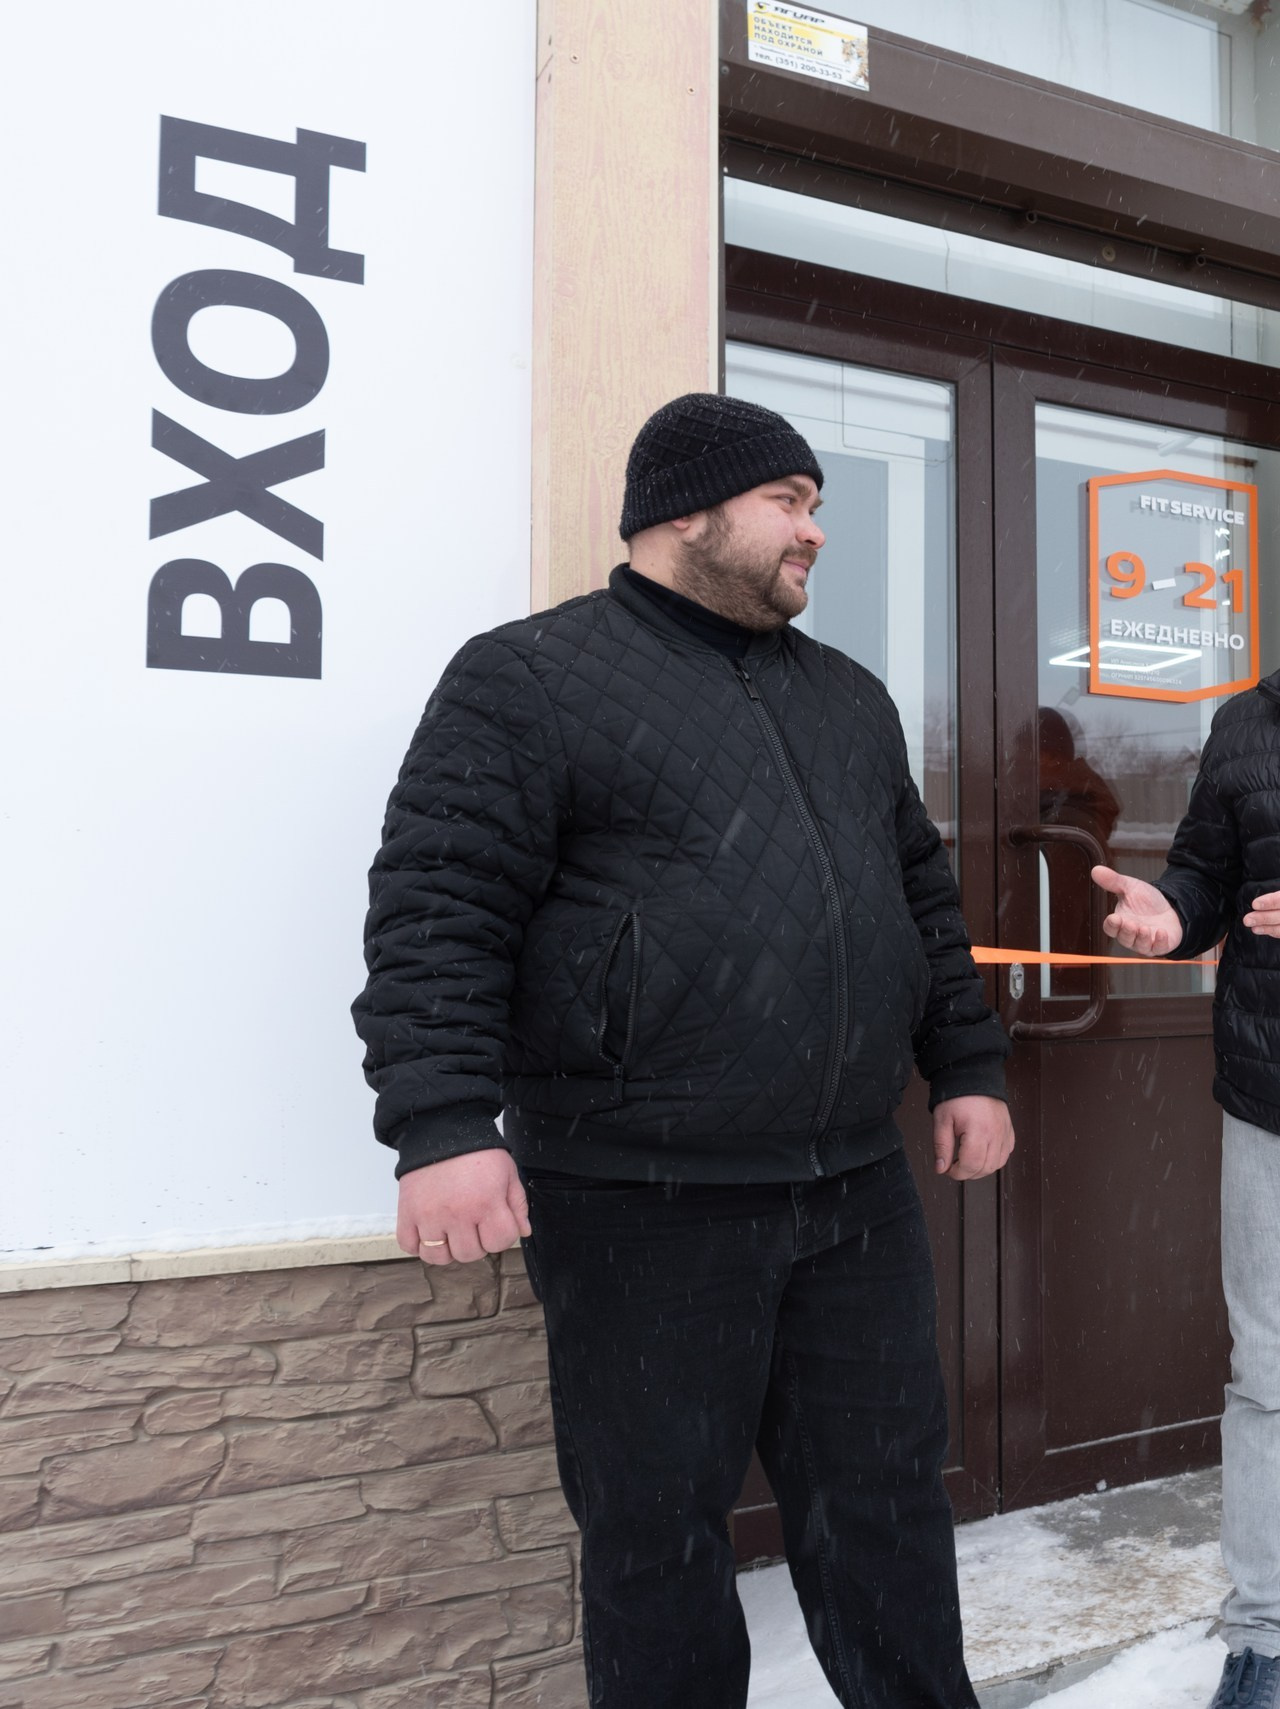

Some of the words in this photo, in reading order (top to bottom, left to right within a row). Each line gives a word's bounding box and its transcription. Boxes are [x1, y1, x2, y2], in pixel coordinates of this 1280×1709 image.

[754, 17, 792, 31] ОБЪЕКТ
[754, 24, 813, 45] НАХОДИТСЯ
[754, 33, 775, 43] ПОД
[777, 39, 823, 56] ОХРАНОЙ
[776, 57, 798, 68] (351)
[801, 63, 842, 80] 200-33-53
[146, 114, 366, 680] ВХОД
[1111, 618, 1244, 650] ЕЖЕДНЕВНО
